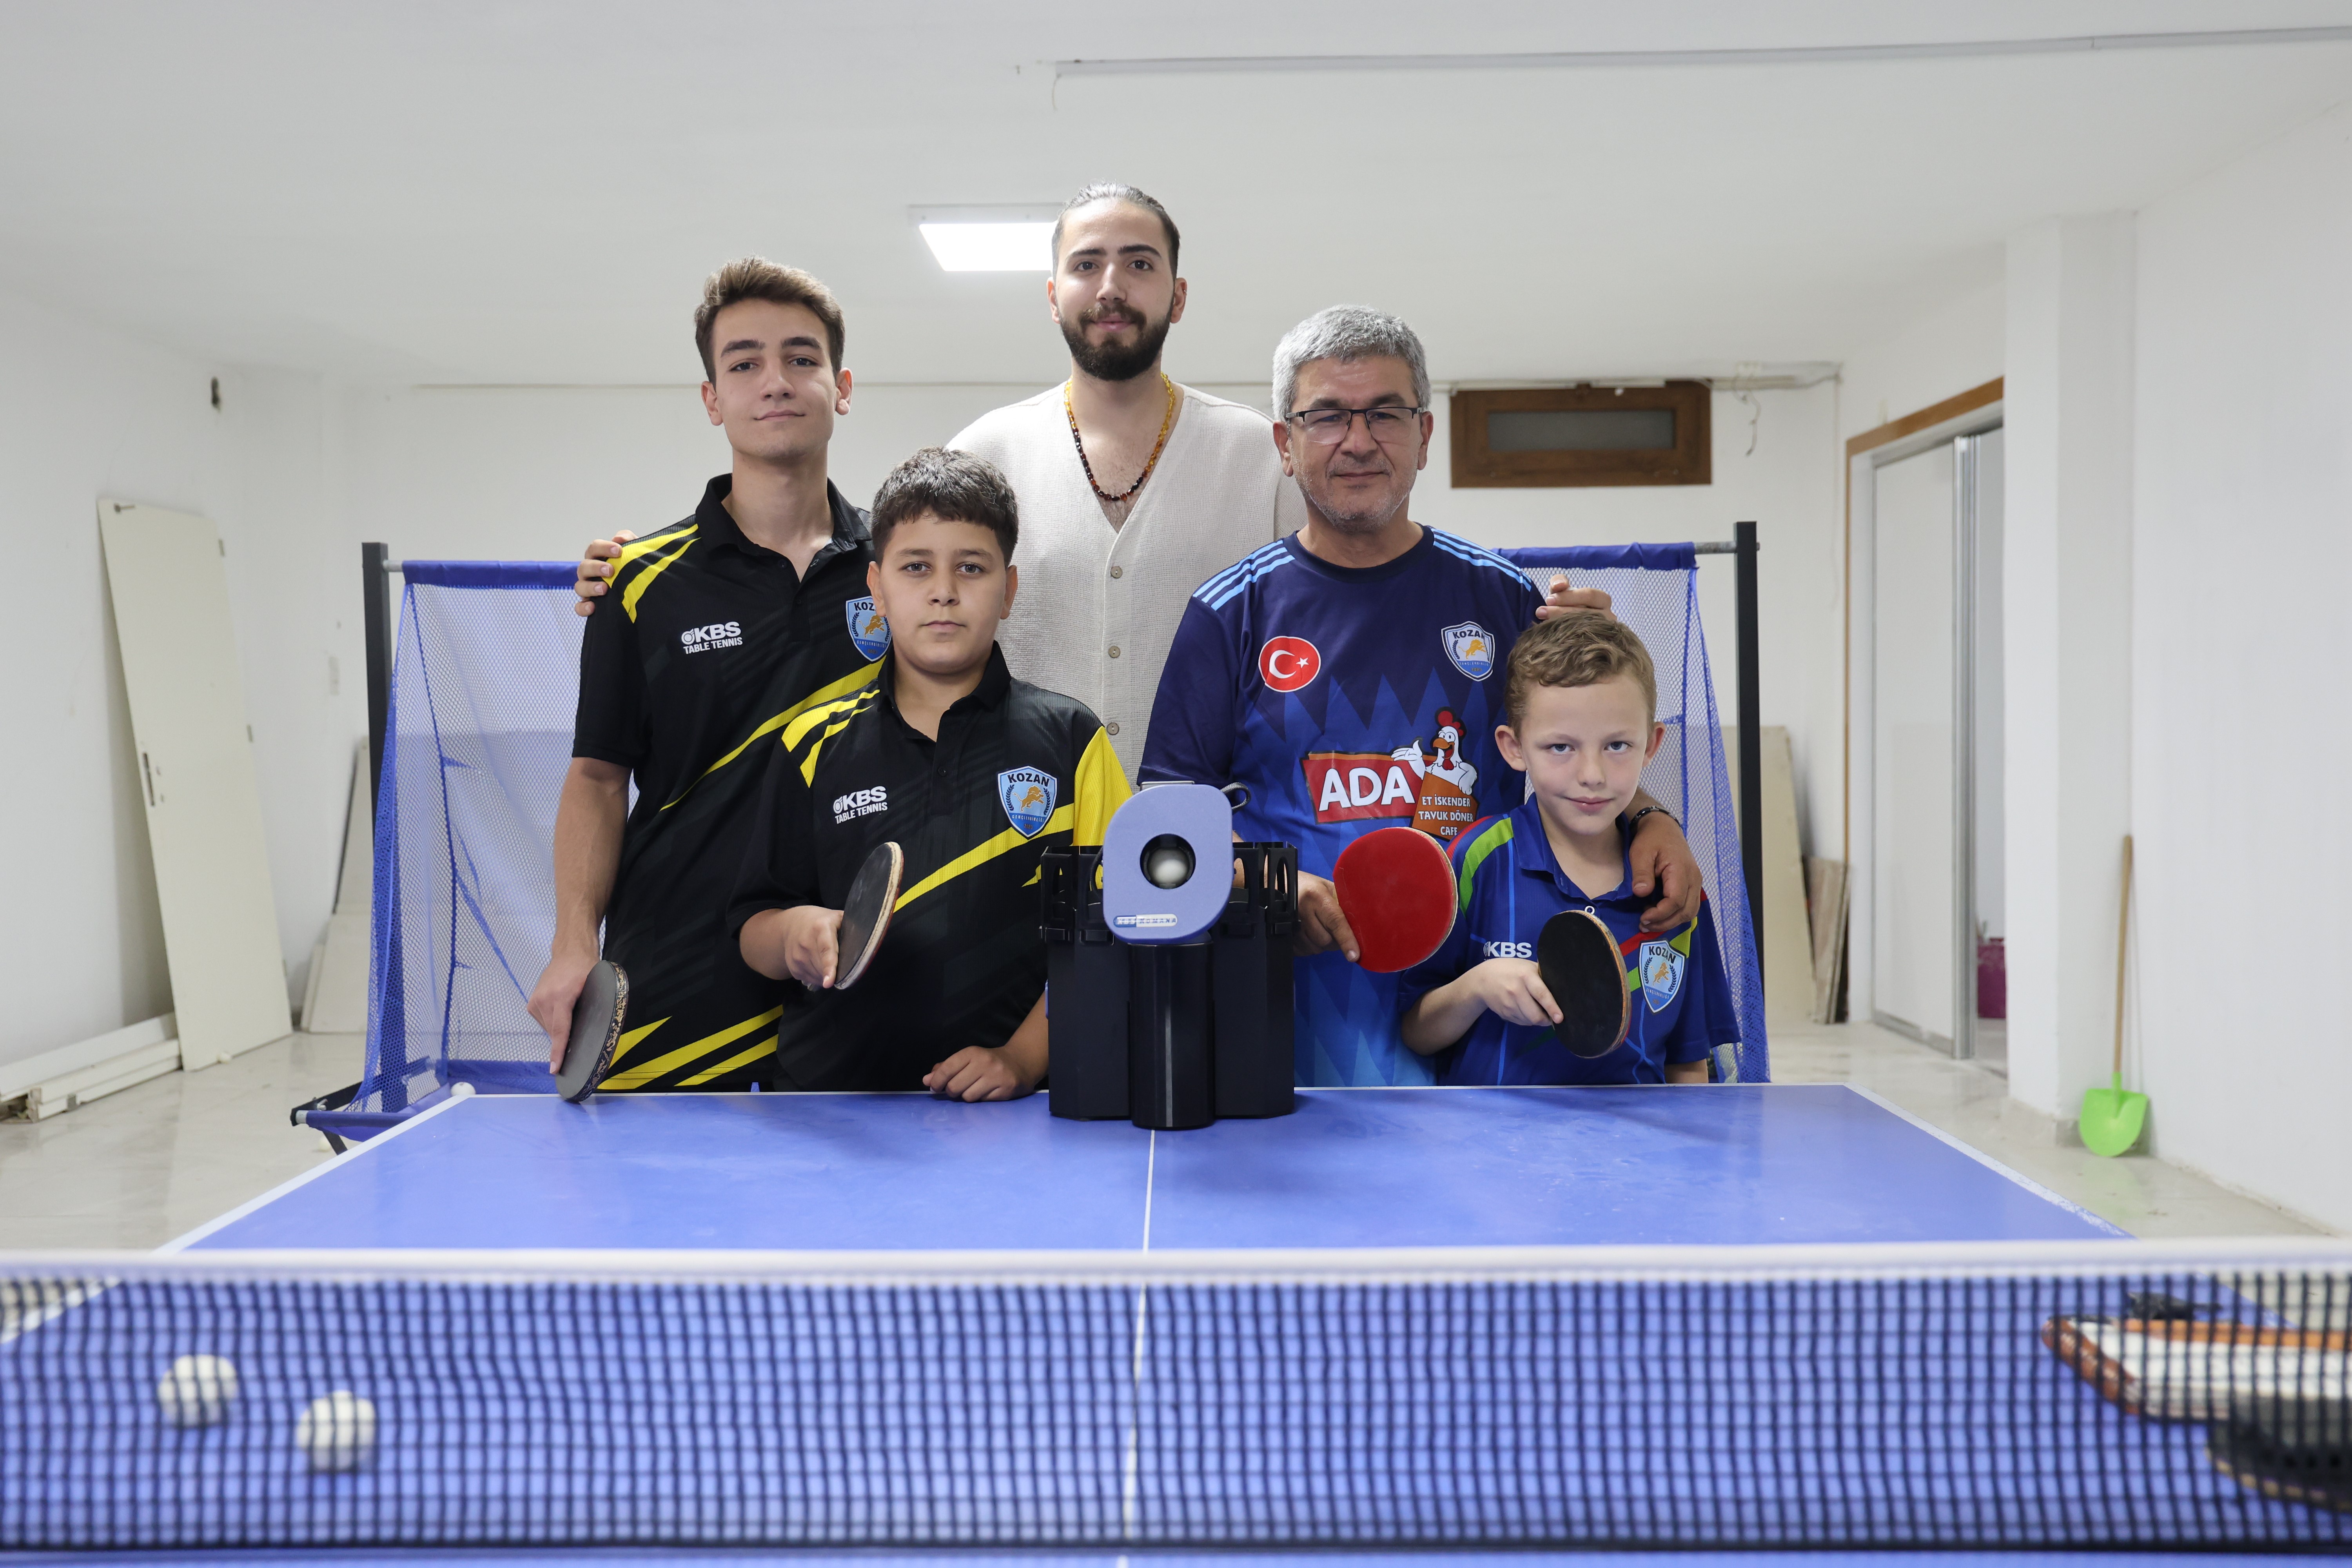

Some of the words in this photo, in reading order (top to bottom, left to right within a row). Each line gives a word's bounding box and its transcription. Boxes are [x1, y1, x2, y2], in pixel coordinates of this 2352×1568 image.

[854, 602, 876, 611] KOZ
[694, 621, 741, 642] KBS
[1452, 630, 1485, 639] KOZAN
[683, 642, 710, 654] TABLE
[710, 637, 743, 649] TENNIS
[1007, 773, 1050, 787] KOZAN
[1318, 766, 1416, 812] ADA
[843, 786, 887, 811] KBS
[1422, 796, 1432, 805] ET
[1434, 794, 1470, 807] İSKENDER
[835, 809, 856, 824] TABLE
[856, 802, 888, 817] TENNIS
[1418, 811, 1448, 820] TAVUK
[1450, 810, 1473, 822] DÖNER
[1440, 826, 1458, 836] CAFE
[1488, 941, 1532, 958] KBS
[1649, 946, 1676, 964] KOZAN
